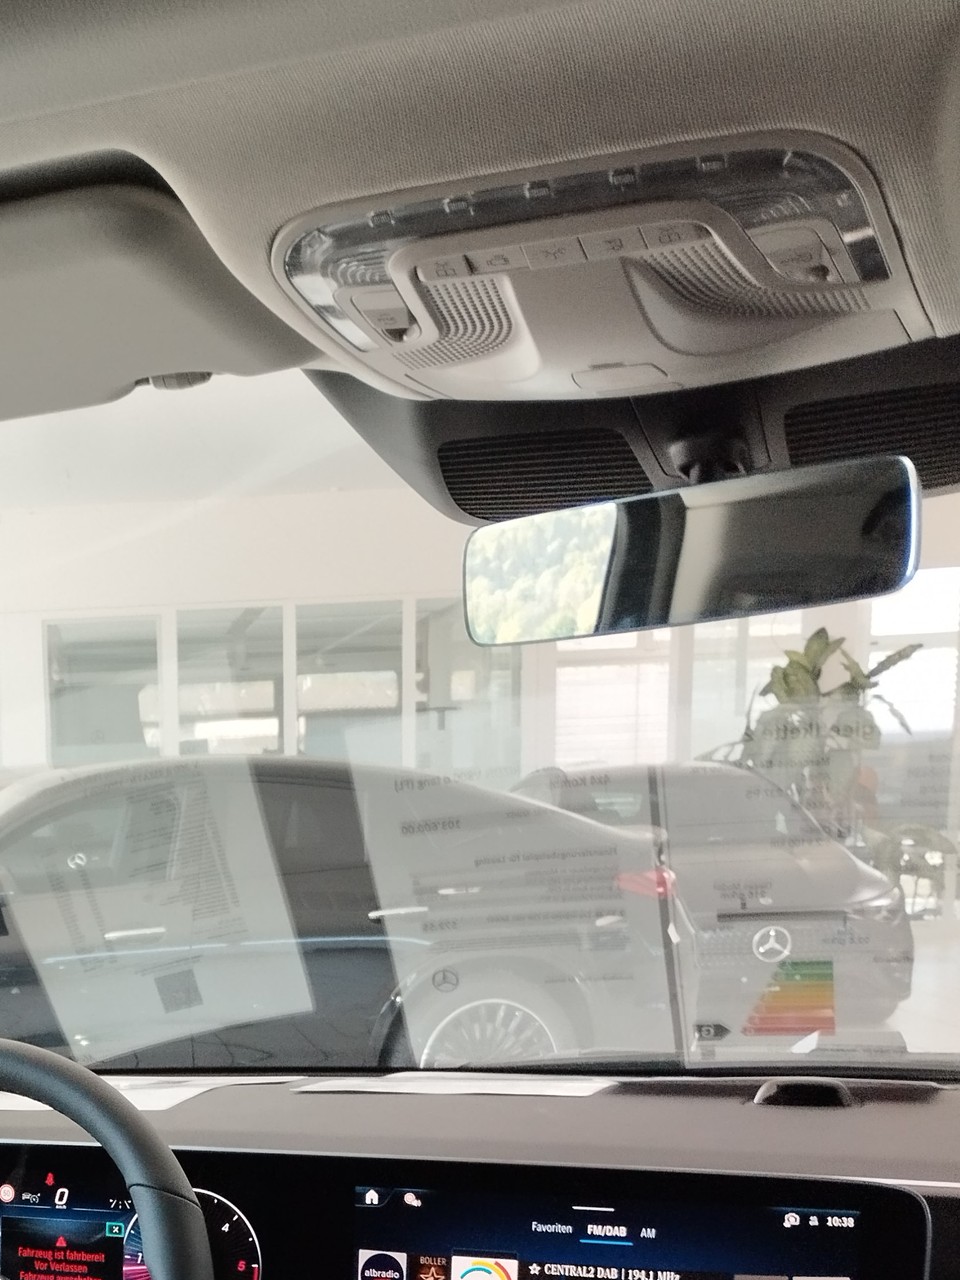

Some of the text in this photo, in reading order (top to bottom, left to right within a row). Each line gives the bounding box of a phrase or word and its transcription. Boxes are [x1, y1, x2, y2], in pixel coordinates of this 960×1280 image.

[221, 1222, 230, 1233] 4
[531, 1221, 656, 1239] Favoriten FM/DAB AM
[18, 1247, 105, 1263] Fahrzeug ist fahrbereit
[419, 1256, 447, 1266] BOLLER
[34, 1260, 88, 1273] Vor Verlassen
[237, 1260, 247, 1271] 5
[544, 1263, 595, 1278] CENTRAL2
[596, 1267, 618, 1280] DAB
[364, 1268, 400, 1279] albradio
